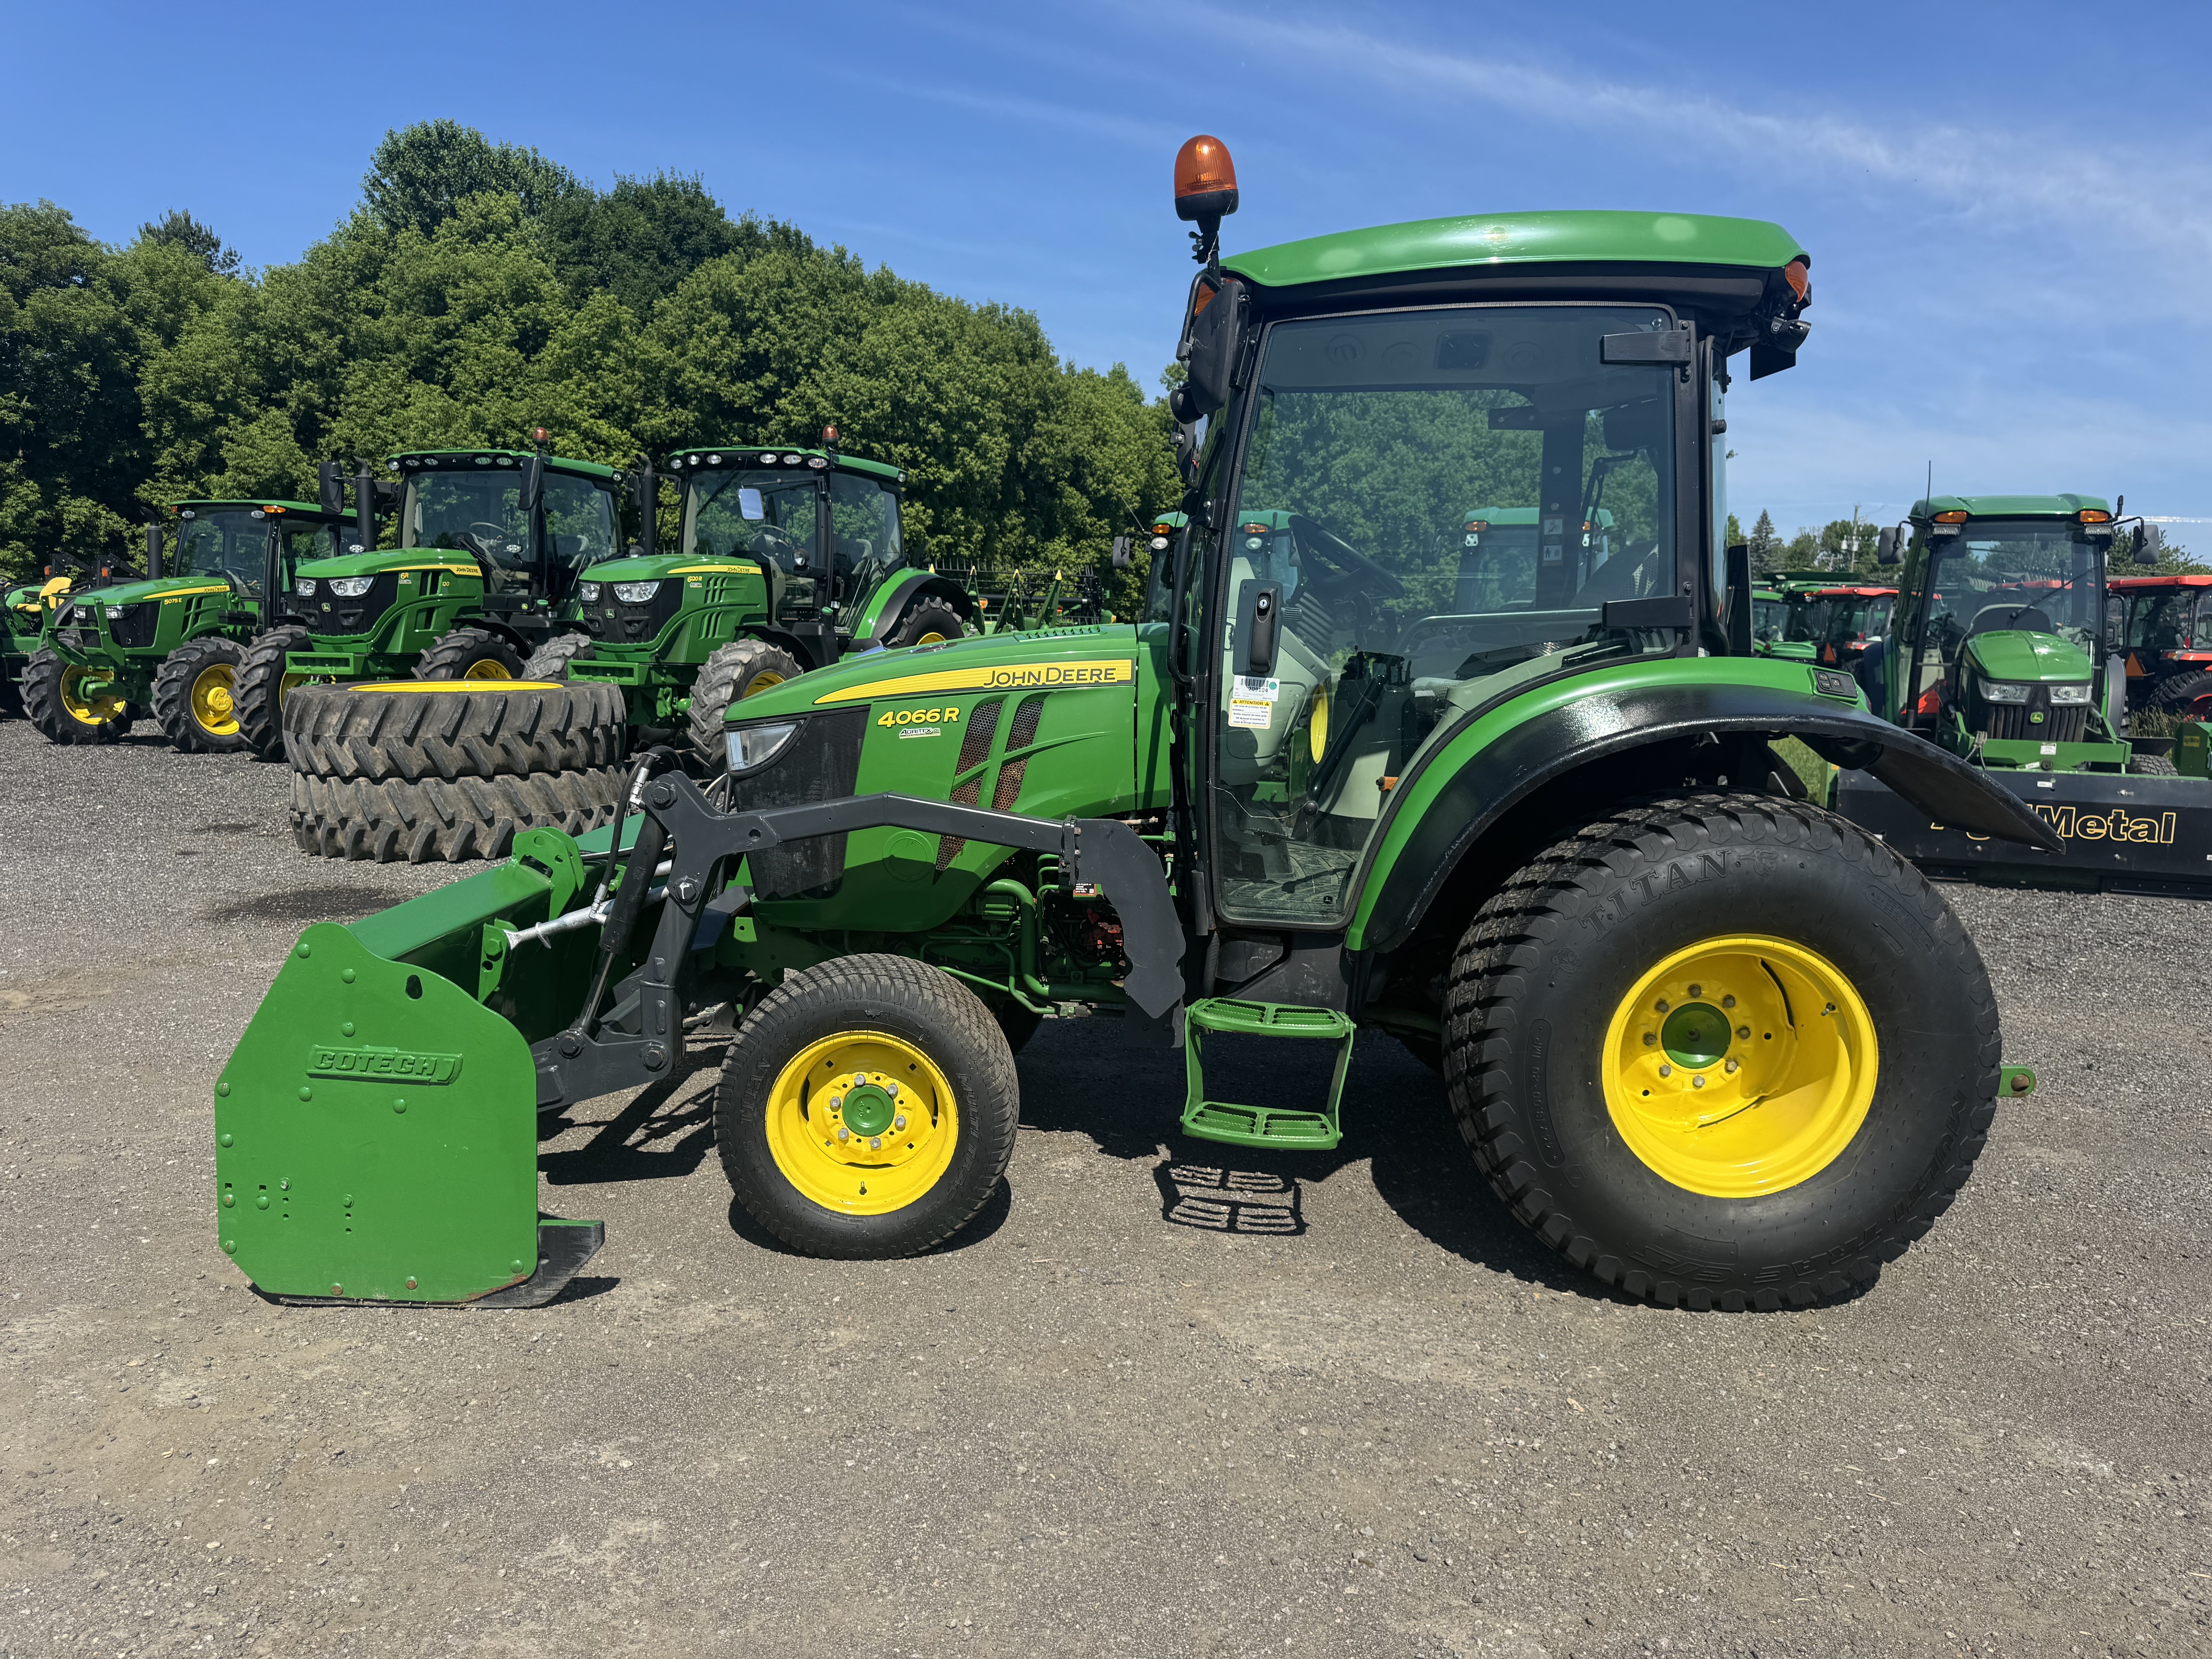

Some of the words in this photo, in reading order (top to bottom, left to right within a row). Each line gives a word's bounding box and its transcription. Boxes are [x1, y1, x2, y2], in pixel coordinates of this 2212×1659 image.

[984, 670, 1041, 687] JOHN
[1046, 668, 1117, 685] DEERE
[1579, 850, 1731, 941] TITAN
[313, 1051, 438, 1076] COTECH
[740, 1057, 771, 1123] TITAN
[956, 1073, 980, 1139] MULTI
[946, 1144, 977, 1199] TRAC
[1894, 1089, 1967, 1224] MULTI
[1753, 1223, 1883, 1284] TRAC
